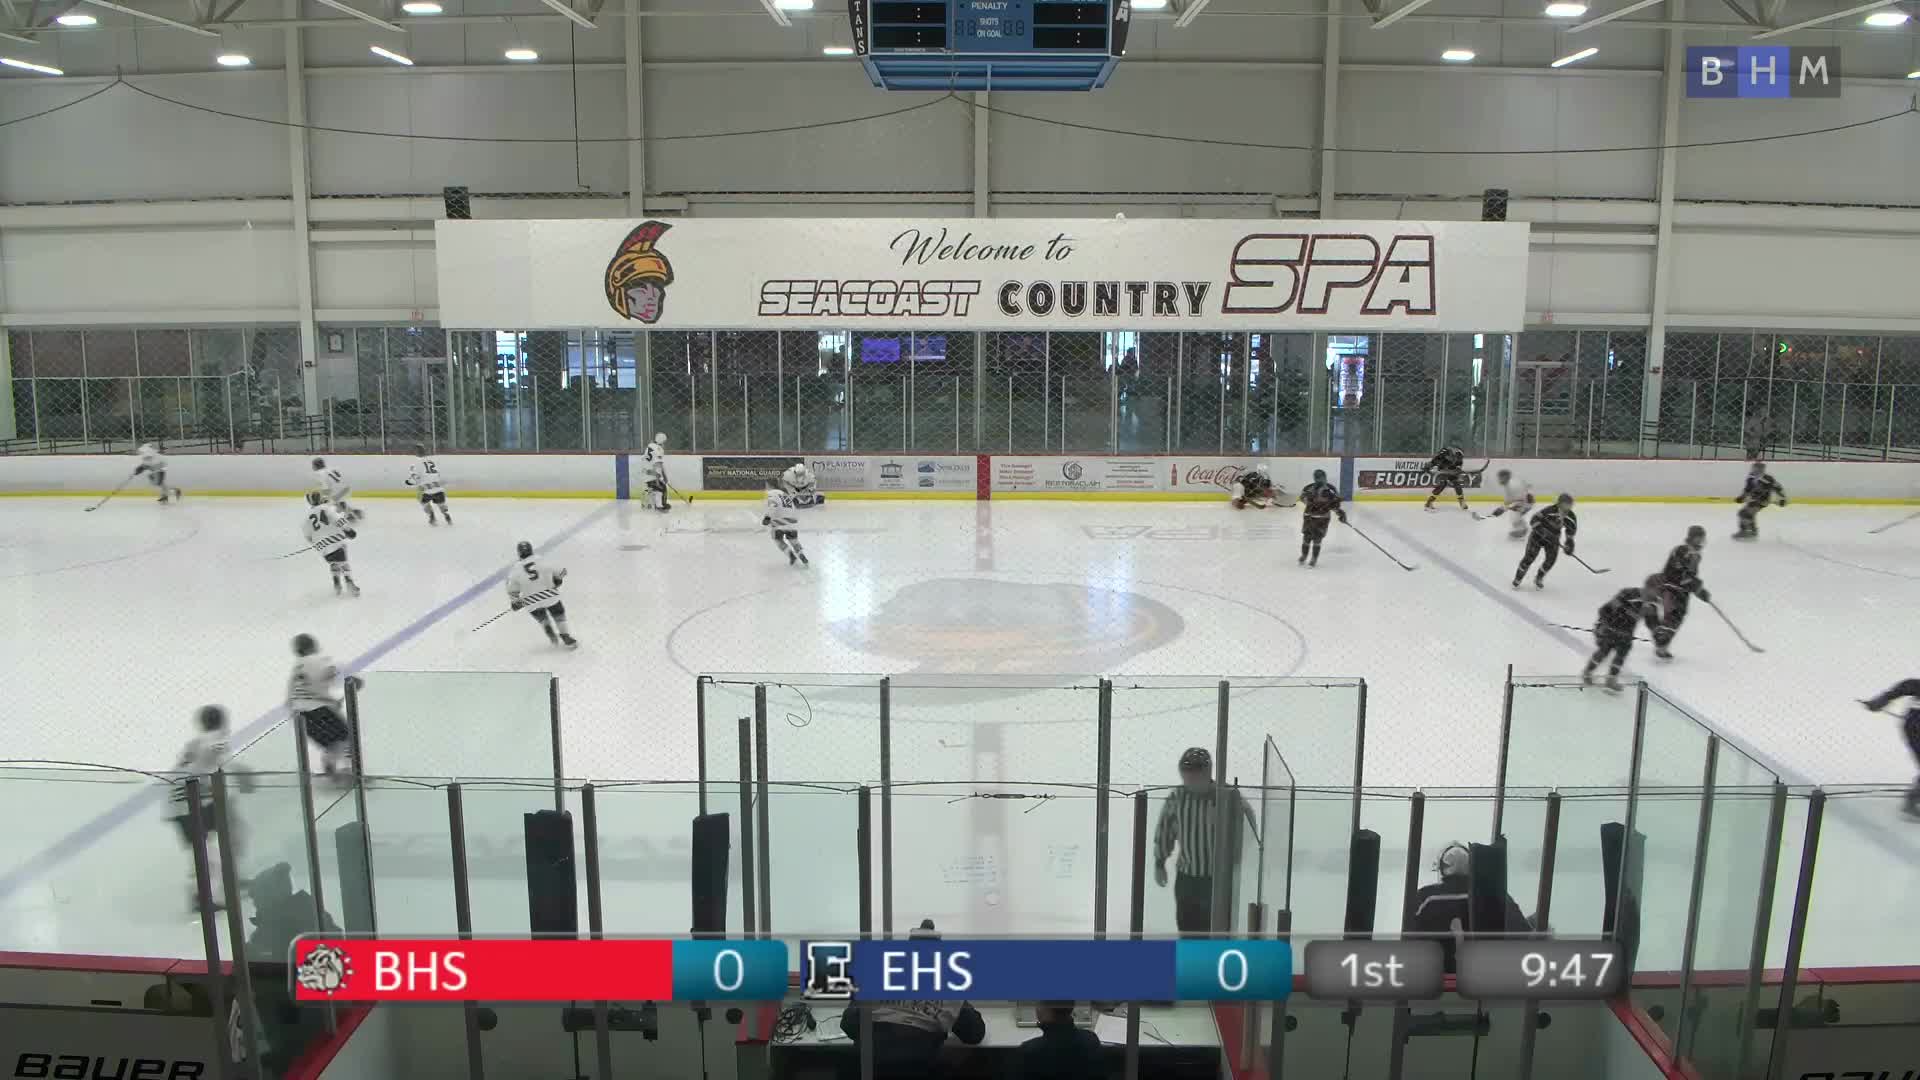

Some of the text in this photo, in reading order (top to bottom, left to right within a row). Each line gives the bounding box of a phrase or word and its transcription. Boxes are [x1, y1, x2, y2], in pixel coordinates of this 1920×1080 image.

[971, 2, 1008, 10] PENALTY
[979, 17, 999, 26] SHOTS
[976, 29, 1002, 38] ON GOAL
[889, 228, 1078, 266] Welcome to
[758, 233, 1436, 317] SEACOAST COUNTRY SPA
[423, 461, 438, 474] 12
[1395, 461, 1419, 470] WATCH
[309, 509, 329, 531] 24
[523, 561, 539, 581] 5
